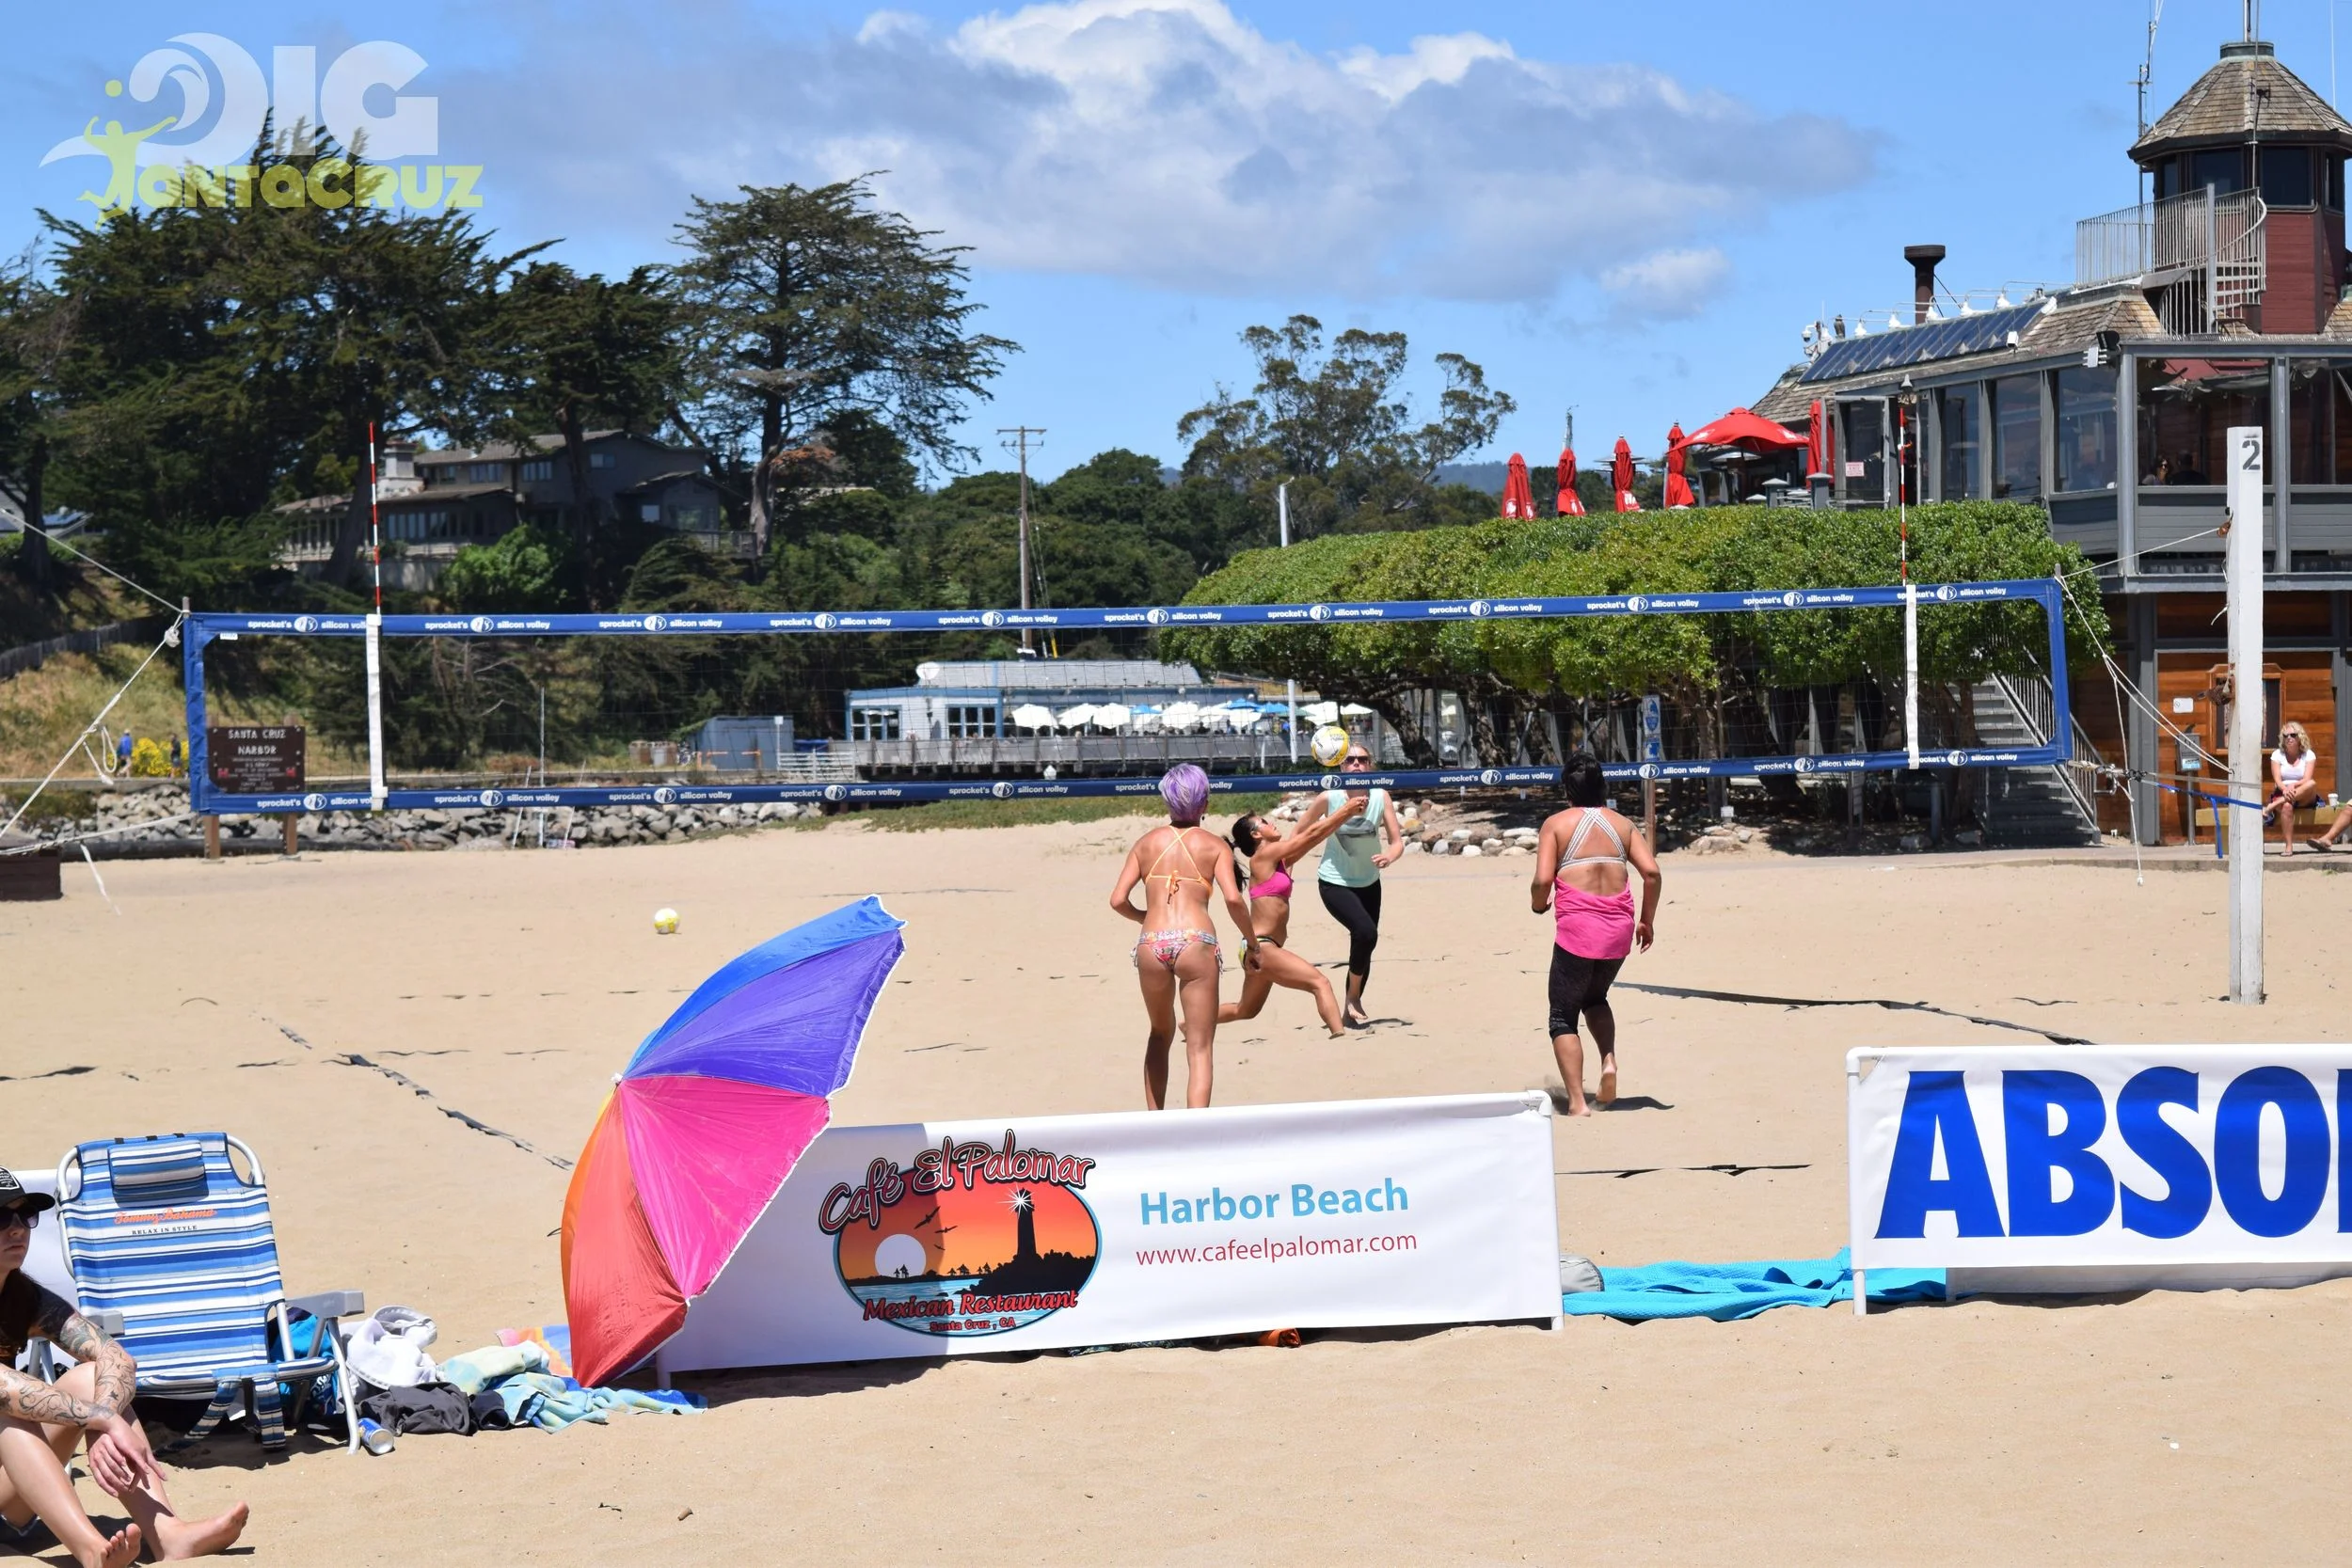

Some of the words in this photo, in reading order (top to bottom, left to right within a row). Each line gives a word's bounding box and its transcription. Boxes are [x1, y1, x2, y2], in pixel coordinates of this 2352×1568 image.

[2242, 439, 2261, 470] 2
[1959, 588, 1983, 596] silicon
[1984, 587, 2006, 595] volley
[1586, 601, 1626, 610] sprocket's
[1650, 599, 1676, 608] silicon
[1677, 598, 1699, 608] volley
[1742, 596, 1781, 606] sprocket's
[1805, 594, 1831, 603] silicon
[1832, 594, 1853, 603] volley
[1267, 610, 1308, 619] sprocket's
[1333, 608, 1359, 617] silicon
[1359, 608, 1383, 617] volley
[1428, 605, 1468, 615] sprocket's
[1493, 604, 1518, 612] silicon
[1519, 603, 1542, 612] volley
[769, 617, 813, 627] sprocket's
[839, 617, 866, 626] silicon
[866, 617, 891, 626] volley
[938, 615, 979, 626] sprocket's
[1006, 614, 1033, 624] silicon
[1034, 614, 1057, 624] volley
[1104, 612, 1145, 623] sprocket's
[1171, 611, 1198, 621] silicon
[1198, 611, 1221, 621] volley
[246, 620, 292, 629] sprocket's
[321, 620, 349, 629] silicon
[424, 621, 469, 630] sprocket's
[496, 620, 524, 629] silicon
[525, 620, 550, 630] volley
[598, 619, 642, 629] sprocket's
[669, 618, 697, 627] silicon
[697, 618, 723, 628] volley
[262, 729, 286, 739] CRUZ
[1970, 753, 1994, 762] silicon
[1995, 752, 2017, 762] volley
[1754, 762, 1792, 772] sprocket's
[1817, 760, 1841, 768] silicon
[1843, 758, 1865, 768] volley
[1438, 774, 1478, 784] sprocket's
[1504, 772, 1530, 781] silicon
[1531, 771, 1553, 781] volley
[1601, 768, 1637, 778] procket's
[1662, 767, 1687, 775] silicon
[1688, 765, 1710, 774] volley
[1115, 783, 1155, 792] sprocket's
[1209, 781, 1232, 790] volley
[1277, 779, 1318, 788] sprocket's
[1371, 777, 1393, 785] volley
[609, 792, 651, 801] sprocket's
[679, 791, 707, 800] silicon
[707, 790, 732, 800] volley
[780, 789, 821, 799] sprocket's
[850, 788, 876, 797] silicon
[878, 787, 901, 797] volley
[948, 786, 990, 795] sprocket's
[1017, 785, 1043, 794] silicon
[1044, 784, 1068, 794] volley
[257, 799, 301, 809] sprocket's
[330, 797, 358, 806] silicon
[434, 794, 477, 804] sprocket's
[506, 793, 533, 802] silicon
[534, 793, 559, 803] volley
[1874, 1066, 2352, 1239] ABSO
[819, 1158, 905, 1235] Café
[914, 1136, 954, 1194] El
[952, 1129, 1099, 1190] Palomar
[1140, 1187, 1279, 1225] Harbor
[1291, 1178, 1408, 1217] Beach
[114, 1212, 161, 1226] Tommy
[162, 1207, 217, 1221] Bahama
[1136, 1233, 1417, 1266] www.cafeelpalomar.com
[863, 1295, 955, 1322] Mexican
[959, 1289, 1079, 1315] Restaurant
[930, 1321, 962, 1332] Santa
[964, 1319, 991, 1330] Cruz
[999, 1317, 1016, 1328] CA
